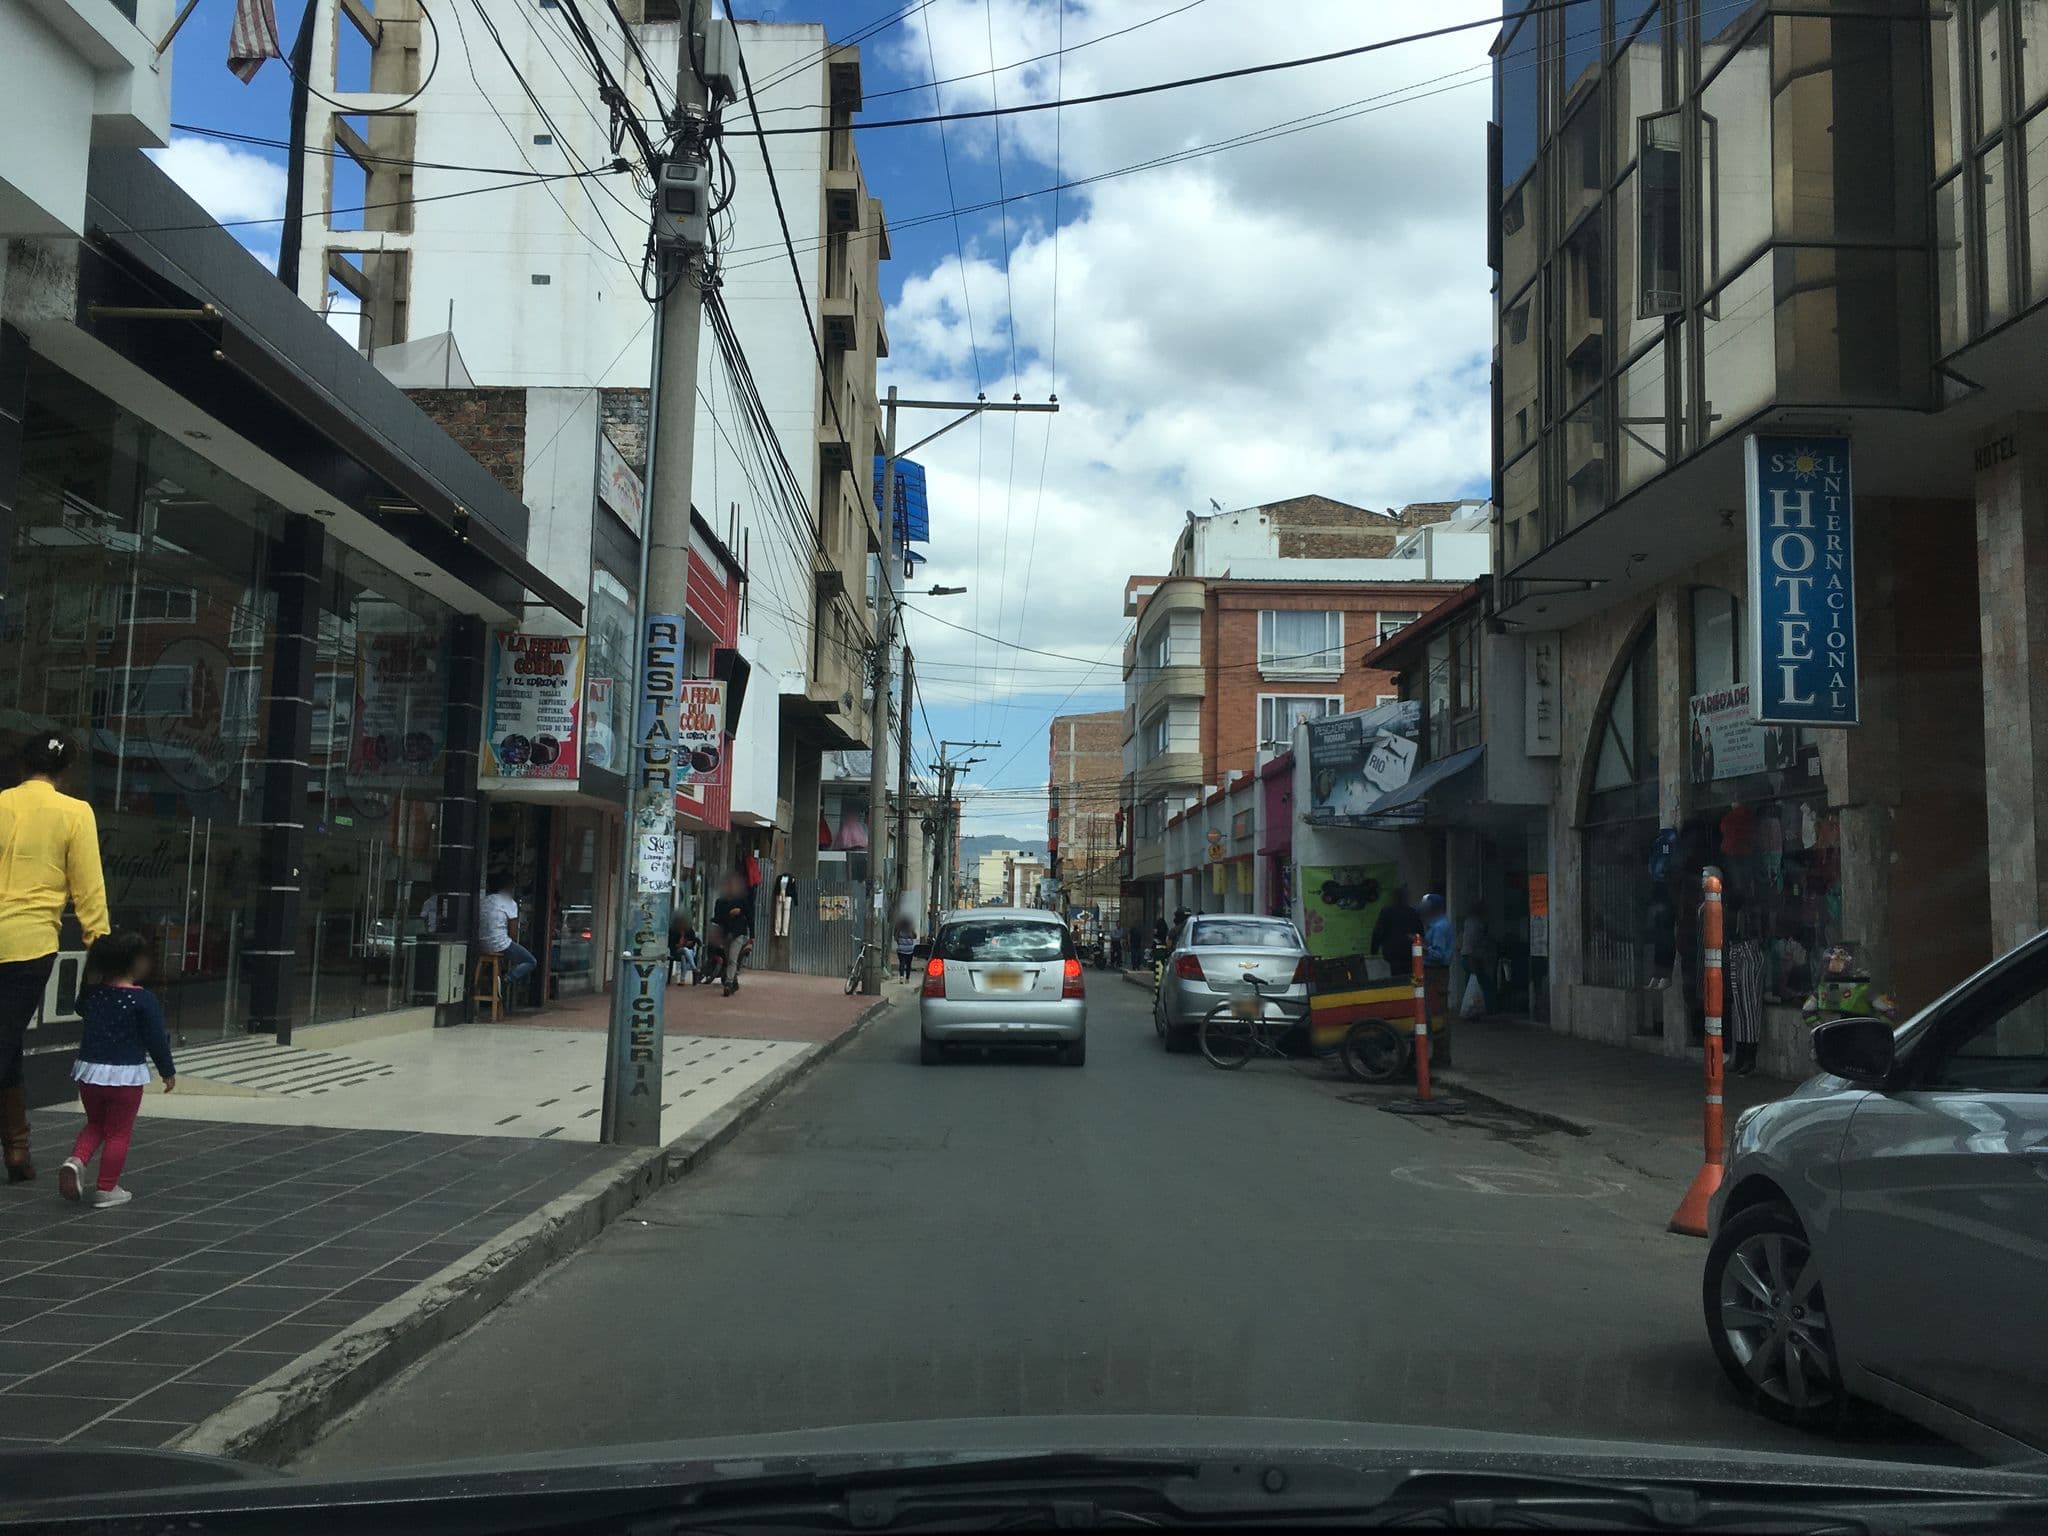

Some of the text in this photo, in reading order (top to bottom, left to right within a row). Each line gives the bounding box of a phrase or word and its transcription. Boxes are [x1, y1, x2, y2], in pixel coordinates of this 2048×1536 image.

[1975, 433, 2018, 472] HOTEL
[1769, 488, 1816, 704] HOTEL
[508, 637, 571, 654] LA FERIA
[690, 687, 721, 705] FERIA
[1368, 755, 1386, 774] RIO
